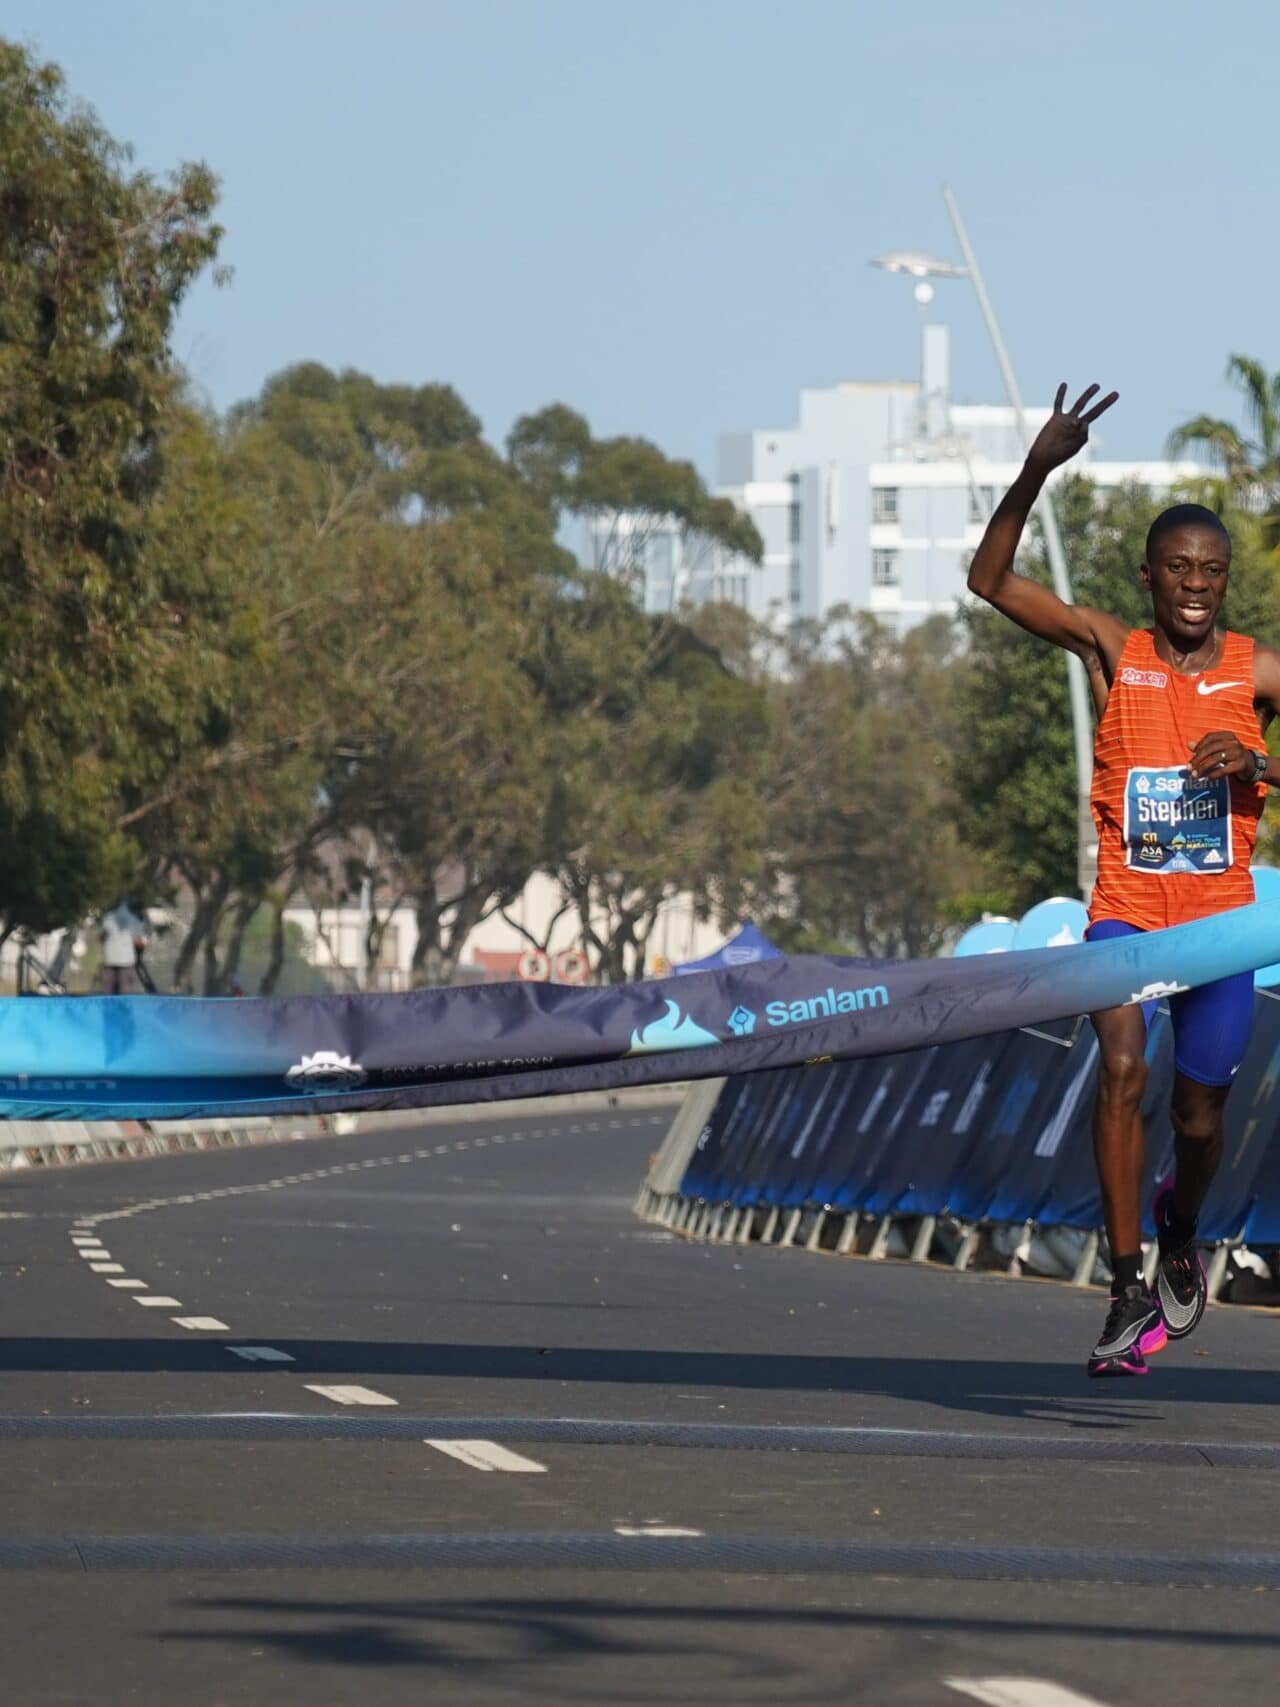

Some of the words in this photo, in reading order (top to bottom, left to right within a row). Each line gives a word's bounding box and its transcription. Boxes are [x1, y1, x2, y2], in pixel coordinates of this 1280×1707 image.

[1137, 796, 1218, 827] Stephen
[1141, 846, 1163, 856] ASA
[765, 985, 889, 1026] Sanlam
